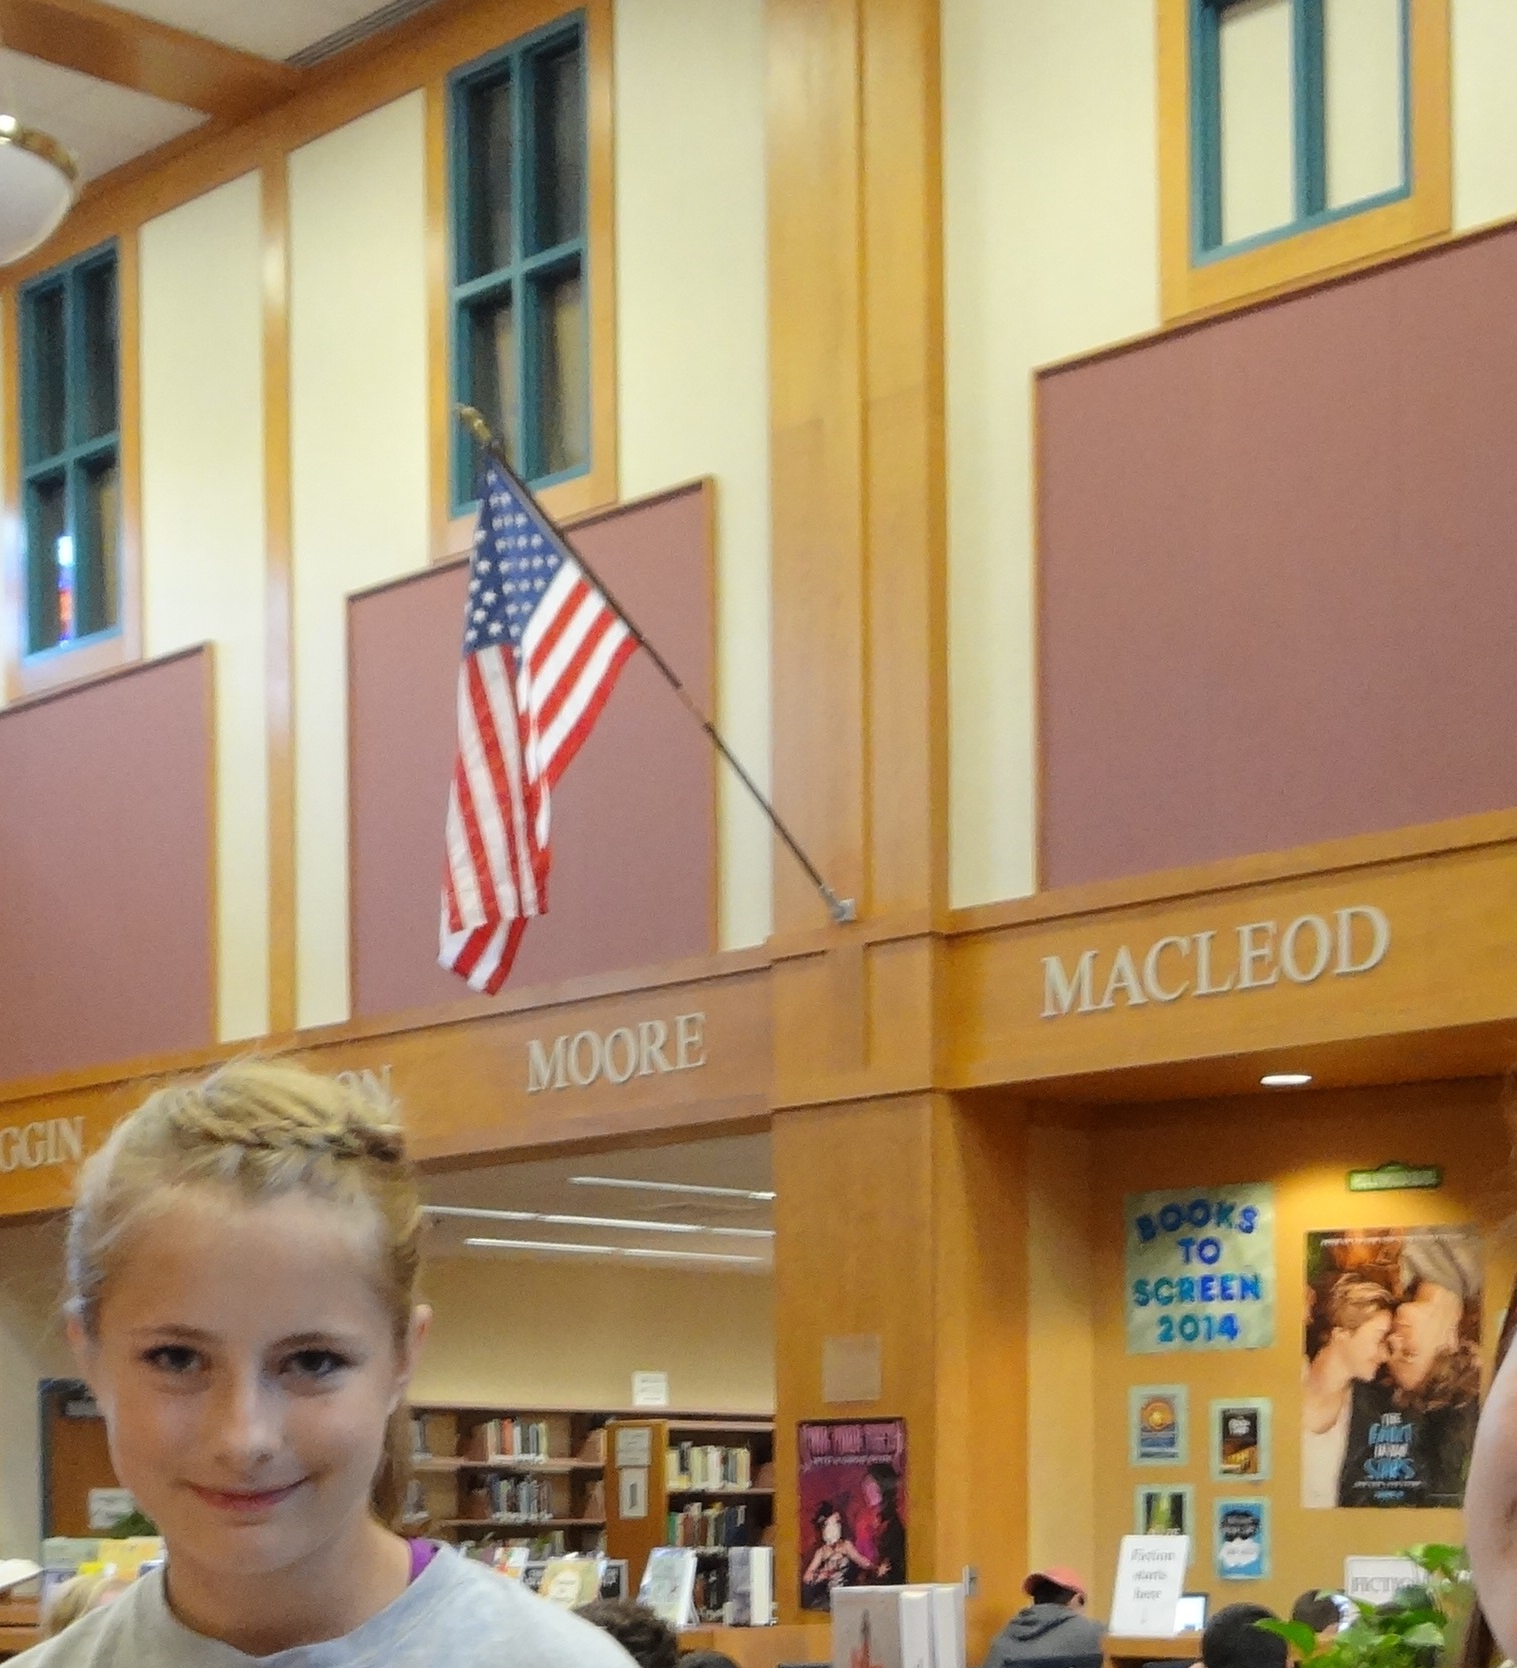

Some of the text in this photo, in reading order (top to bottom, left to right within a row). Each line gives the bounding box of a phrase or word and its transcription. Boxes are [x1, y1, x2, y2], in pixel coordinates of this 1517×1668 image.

[1039, 904, 1392, 1019] MACLEOD
[527, 1012, 707, 1093] MOORE
[1135, 1198, 1260, 1243] BOOKS
[1176, 1236, 1222, 1264] TO
[1133, 1272, 1262, 1308] SCREEN
[1157, 1313, 1240, 1344] 2014
